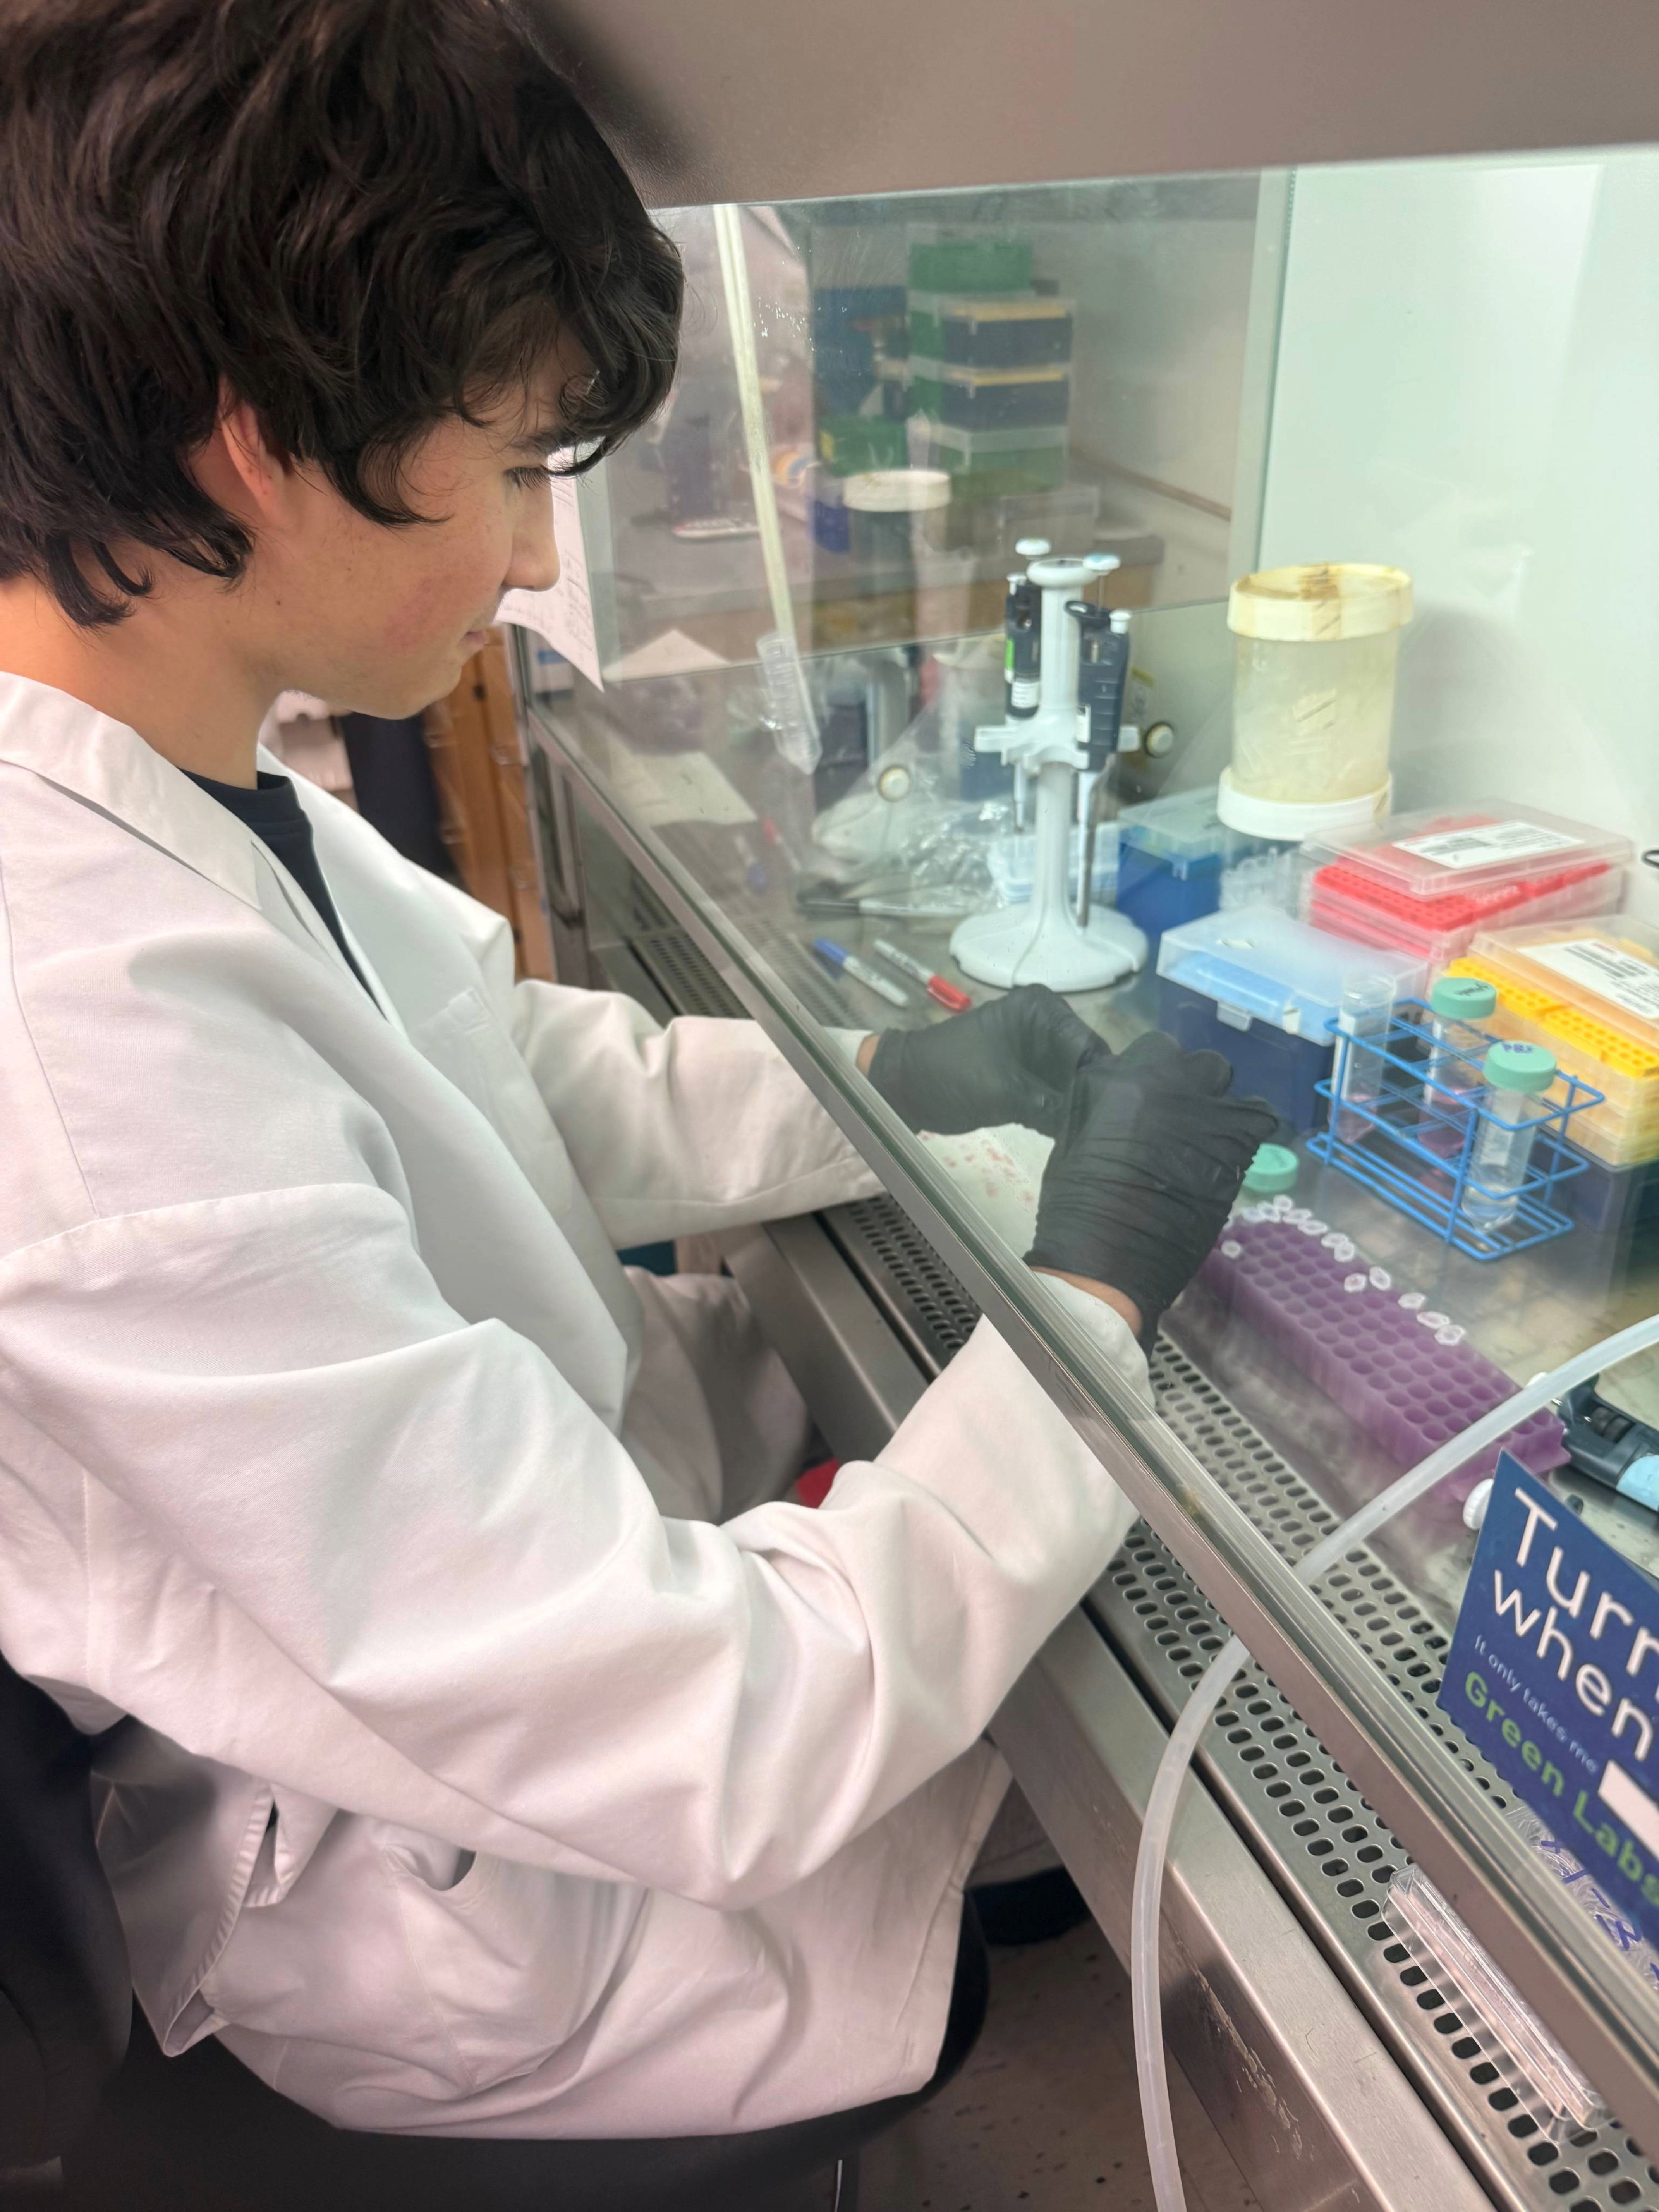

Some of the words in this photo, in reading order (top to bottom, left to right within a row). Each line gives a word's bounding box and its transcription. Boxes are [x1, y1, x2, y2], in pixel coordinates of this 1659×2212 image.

[1493, 1569, 1654, 1762] when
[1514, 1487, 1659, 1704] Turn
[1465, 1671, 1565, 1797] Green
[1474, 1634, 1487, 1656] It
[1488, 1654, 1522, 1693] only
[1523, 1687, 1568, 1742] takes
